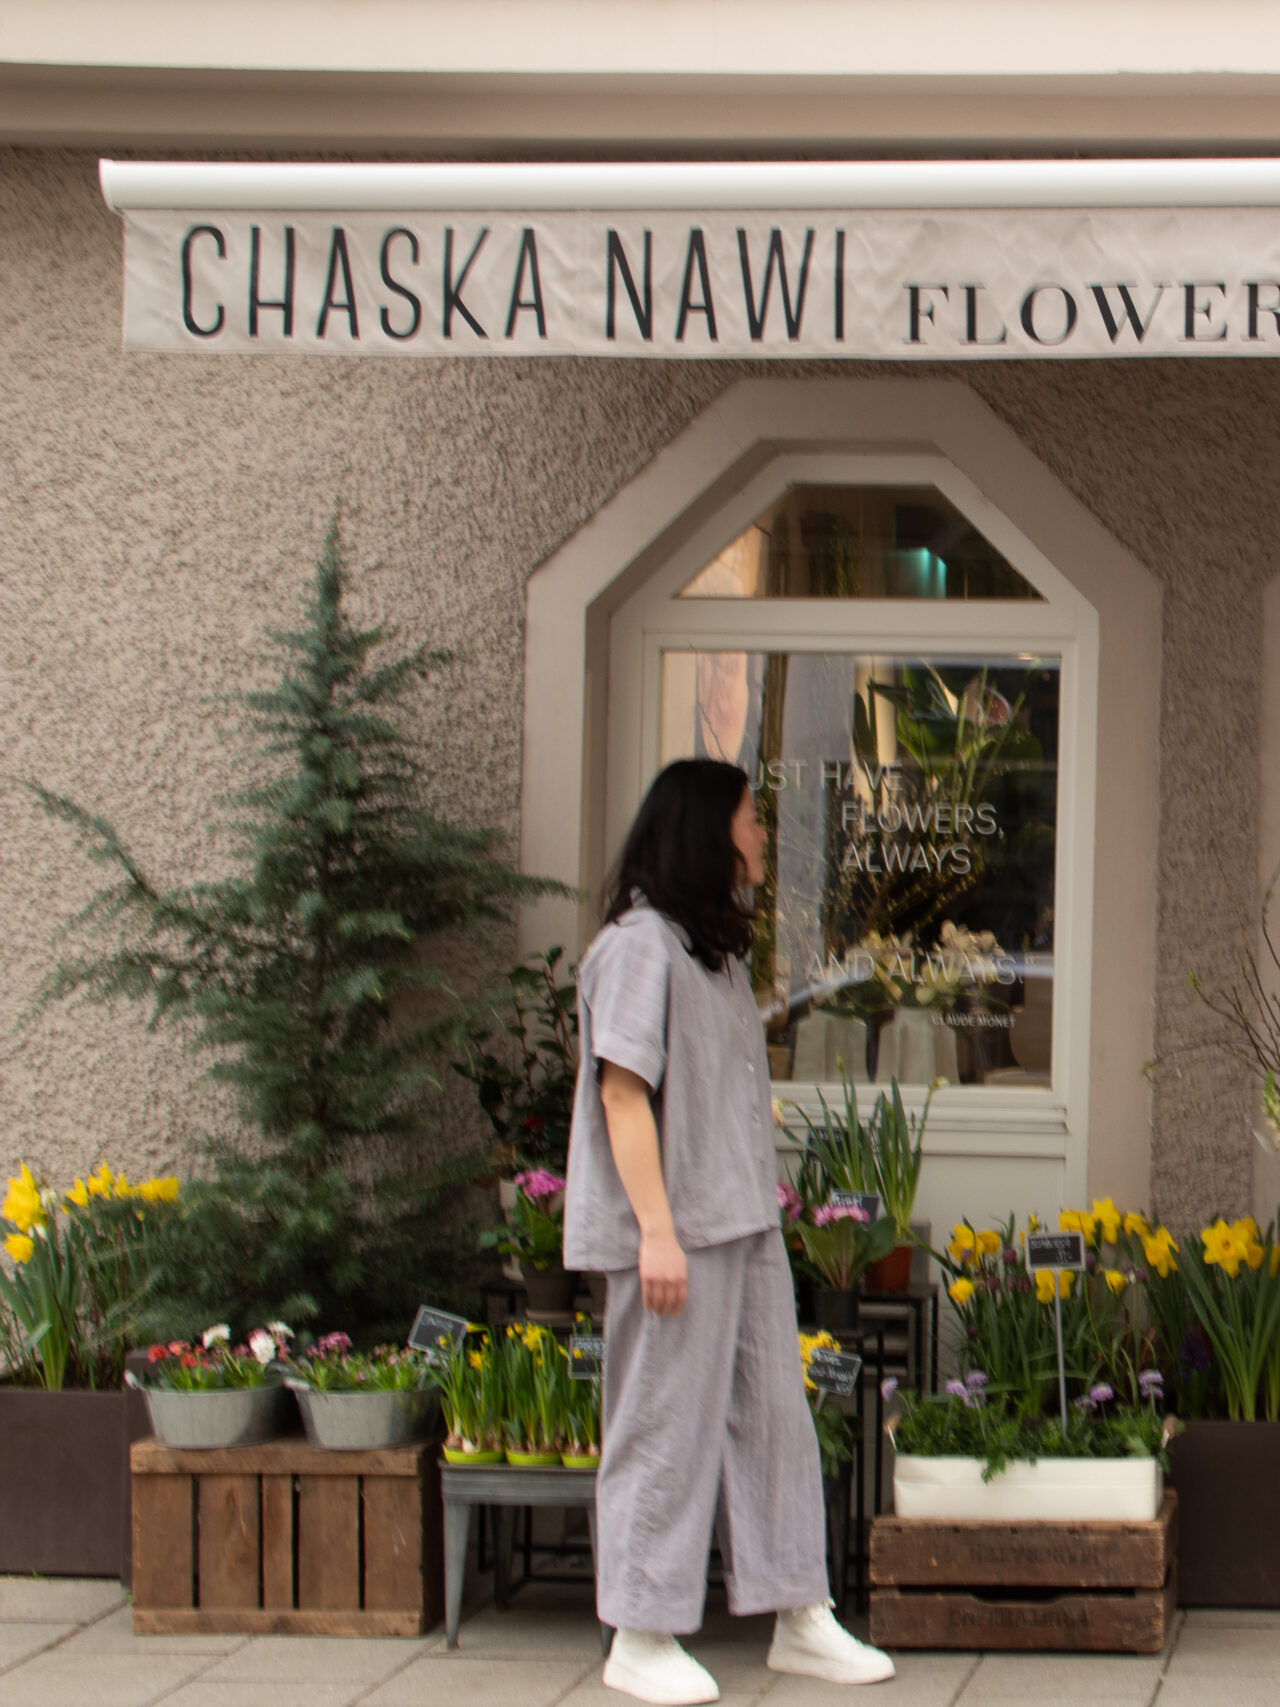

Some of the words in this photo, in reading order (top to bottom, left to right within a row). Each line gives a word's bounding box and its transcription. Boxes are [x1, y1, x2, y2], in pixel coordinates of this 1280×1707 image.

[181, 224, 548, 341] CHASKA
[605, 226, 846, 343] NAWI
[744, 760, 808, 791] UST
[820, 760, 903, 791] HAVE
[841, 801, 1005, 840] FLOWERS,
[842, 842, 972, 875] ALWAYS
[806, 951, 876, 983] AND
[932, 1013, 976, 1027] CLAUDE
[977, 1014, 1017, 1029] MONET
